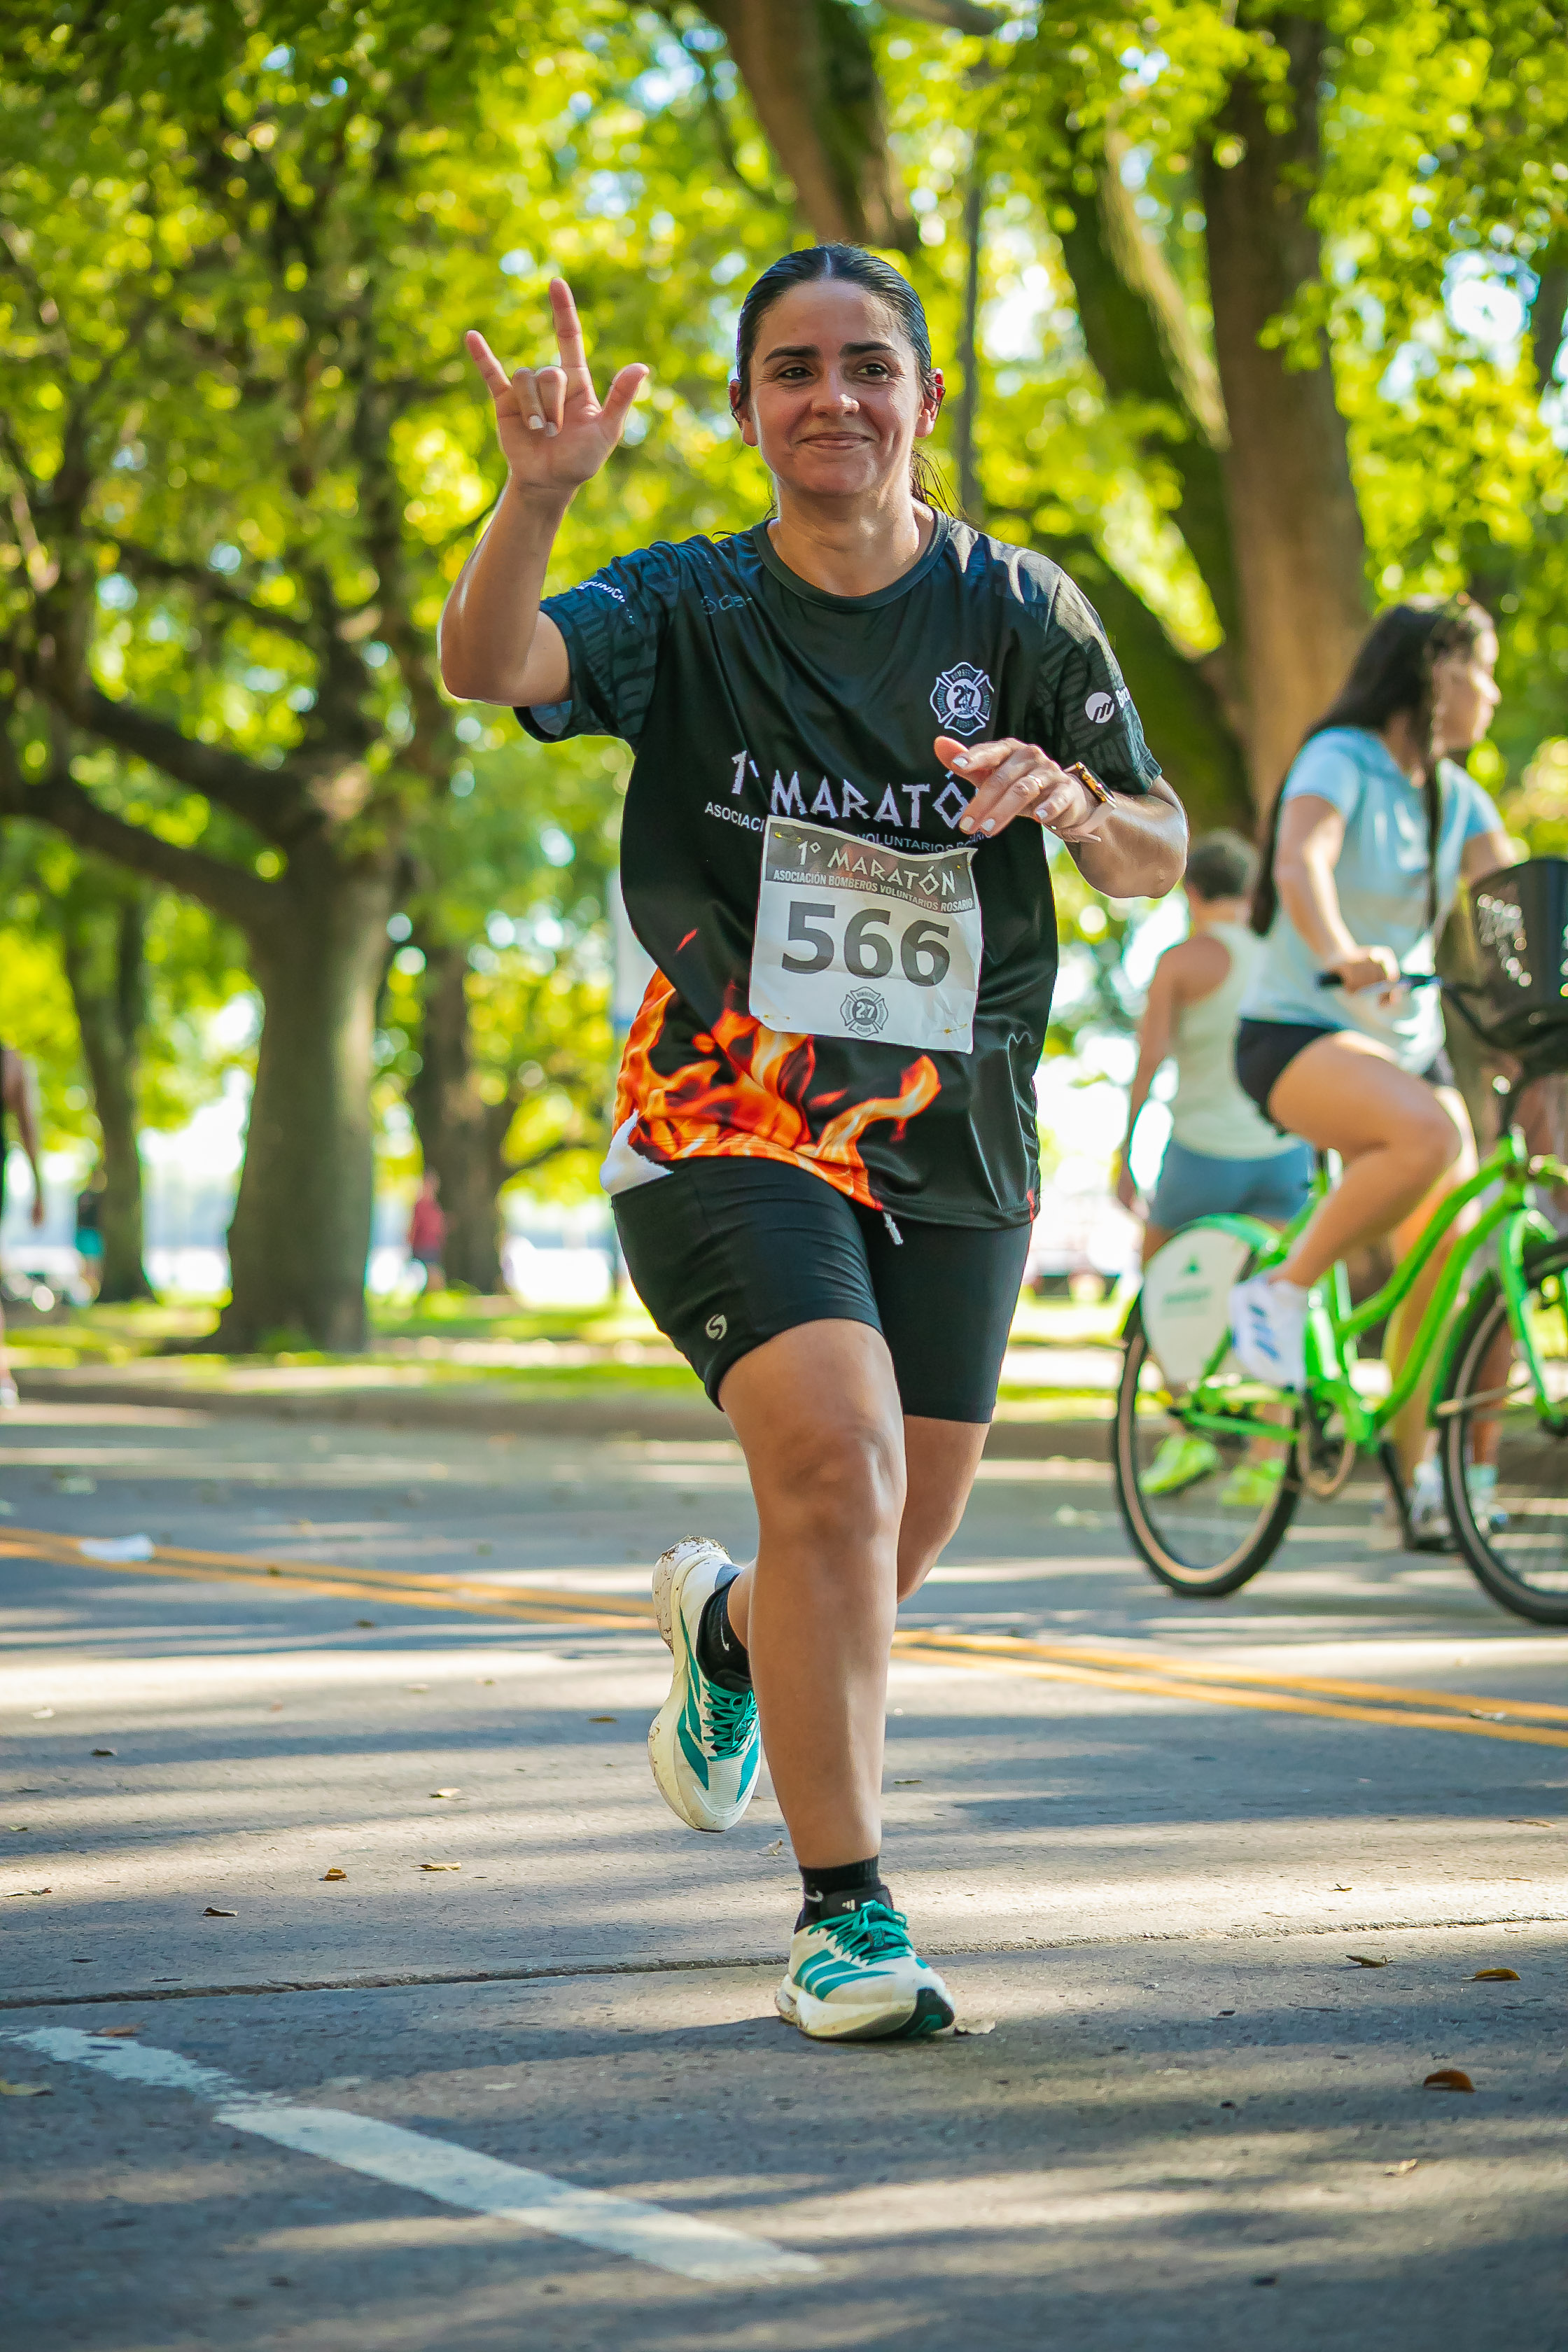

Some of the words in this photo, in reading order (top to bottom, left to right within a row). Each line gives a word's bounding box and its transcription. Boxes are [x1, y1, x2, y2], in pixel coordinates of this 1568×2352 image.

[704, 802, 765, 832] ASOCIACI
[770, 769, 979, 830] MARATÓ
[827, 848, 956, 896] MARATÓN
[828, 875, 878, 892] BOMBEROS
[880, 884, 939, 911] VOLUNTARIOS
[941, 897, 973, 913] ROSARIO
[782, 900, 951, 987] 566
[855, 1001, 875, 1019] 27
